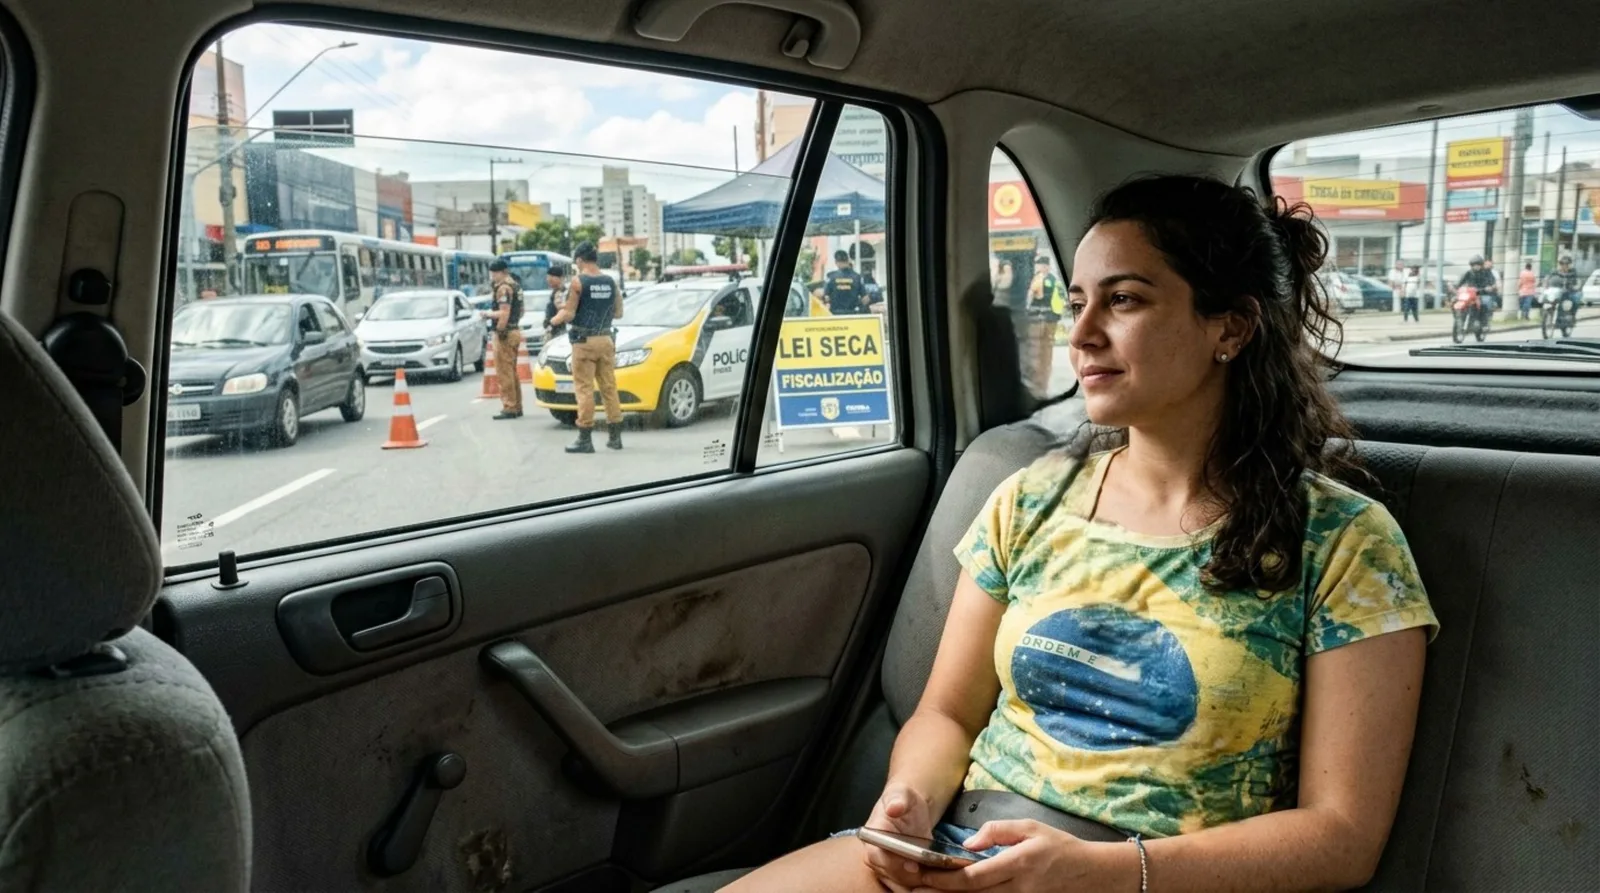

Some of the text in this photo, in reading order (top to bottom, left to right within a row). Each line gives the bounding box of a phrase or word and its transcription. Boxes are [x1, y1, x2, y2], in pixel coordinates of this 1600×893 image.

[780, 334, 878, 359] LEI SECA
[782, 368, 883, 389] FISCALIZAÇÃO
[1022, 635, 1097, 665] ORDEM E
